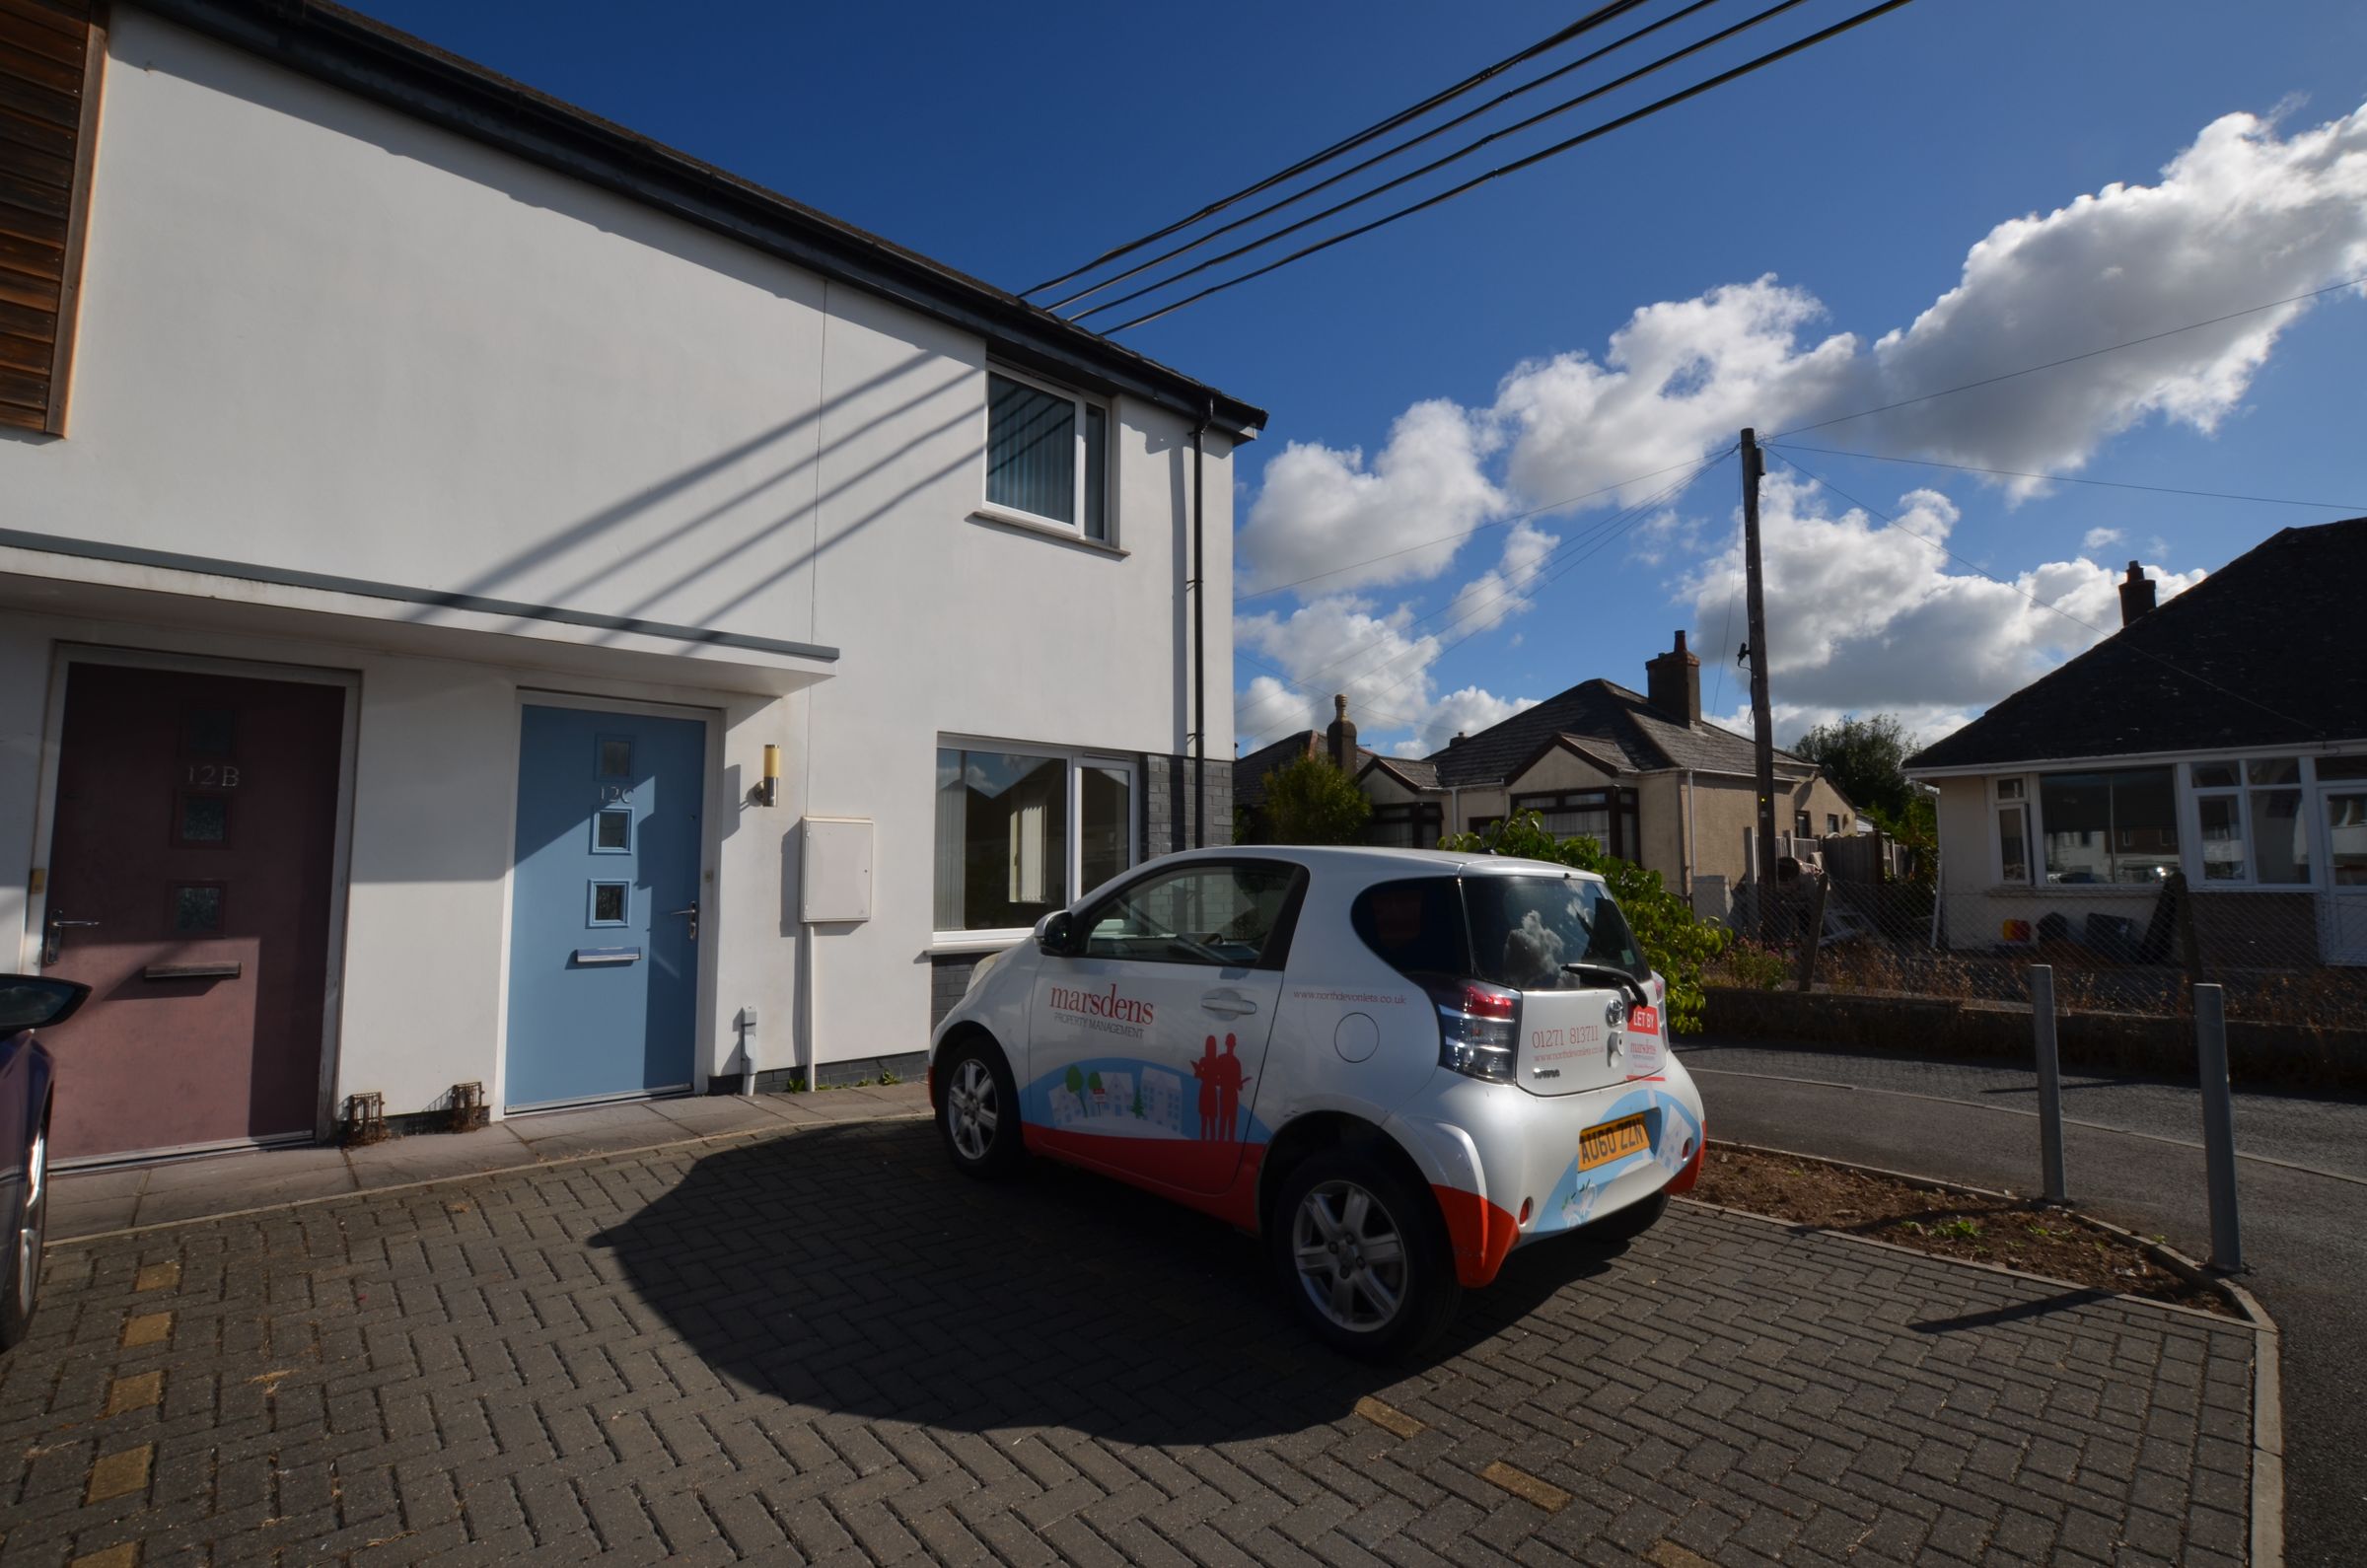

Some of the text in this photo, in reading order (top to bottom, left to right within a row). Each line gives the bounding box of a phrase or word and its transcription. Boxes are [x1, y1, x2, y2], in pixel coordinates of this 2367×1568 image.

[188, 765, 239, 786] 12B
[1049, 983, 1154, 1025] marsdens
[1294, 990, 1406, 1004] www.northdevonlets.co.uk
[1053, 1012, 1144, 1038] PROPERTY MANAGEMENT
[1633, 1011, 1655, 1029] LET BY
[1532, 1026, 1599, 1048] 01271 813711
[1579, 1127, 1616, 1165] AU60
